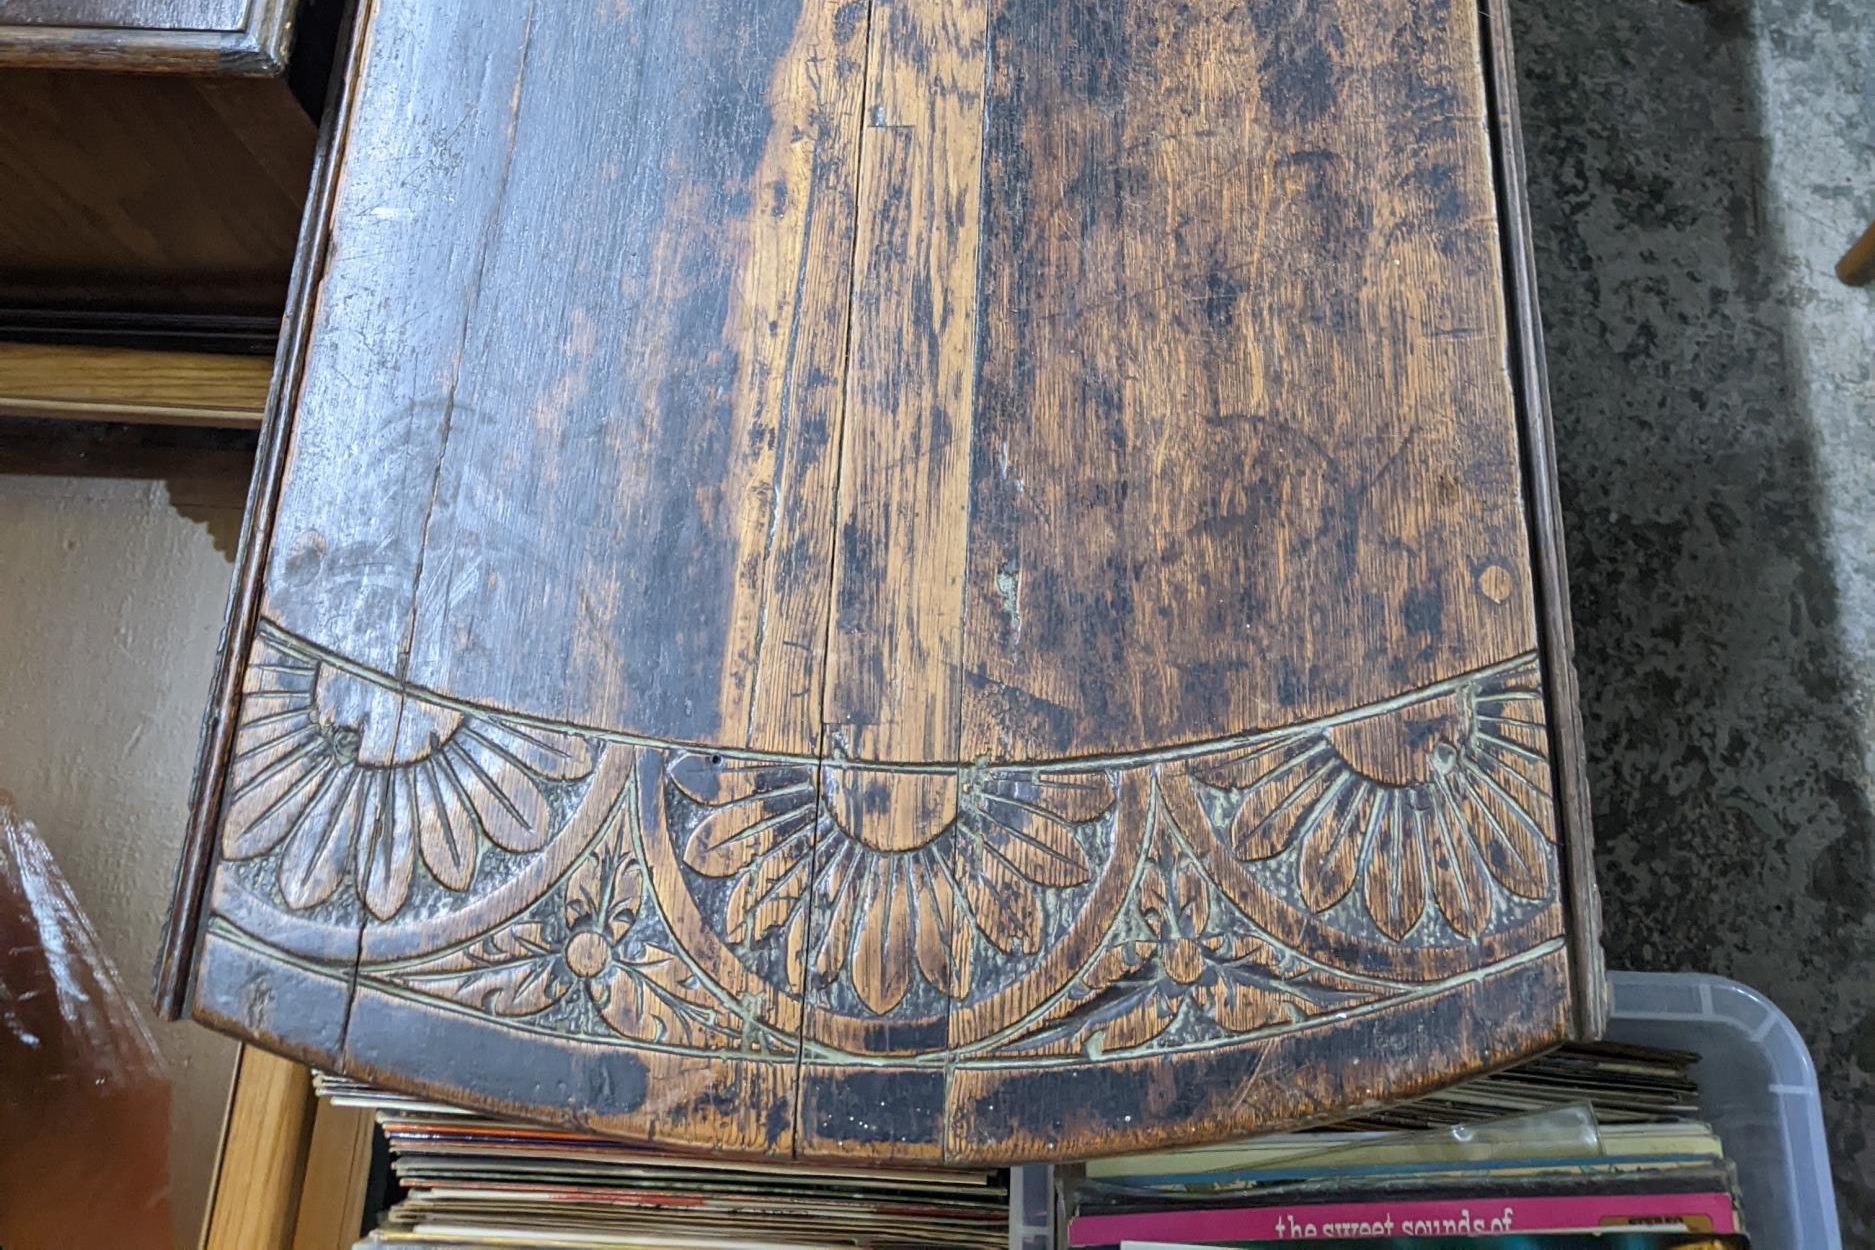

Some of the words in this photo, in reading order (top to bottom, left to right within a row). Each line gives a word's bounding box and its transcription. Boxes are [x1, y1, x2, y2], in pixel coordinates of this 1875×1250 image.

[1275, 1214, 1318, 1239] the
[1322, 1212, 1395, 1237] sweet
[1401, 1208, 1485, 1236] sounds
[1491, 1207, 1514, 1232] of
